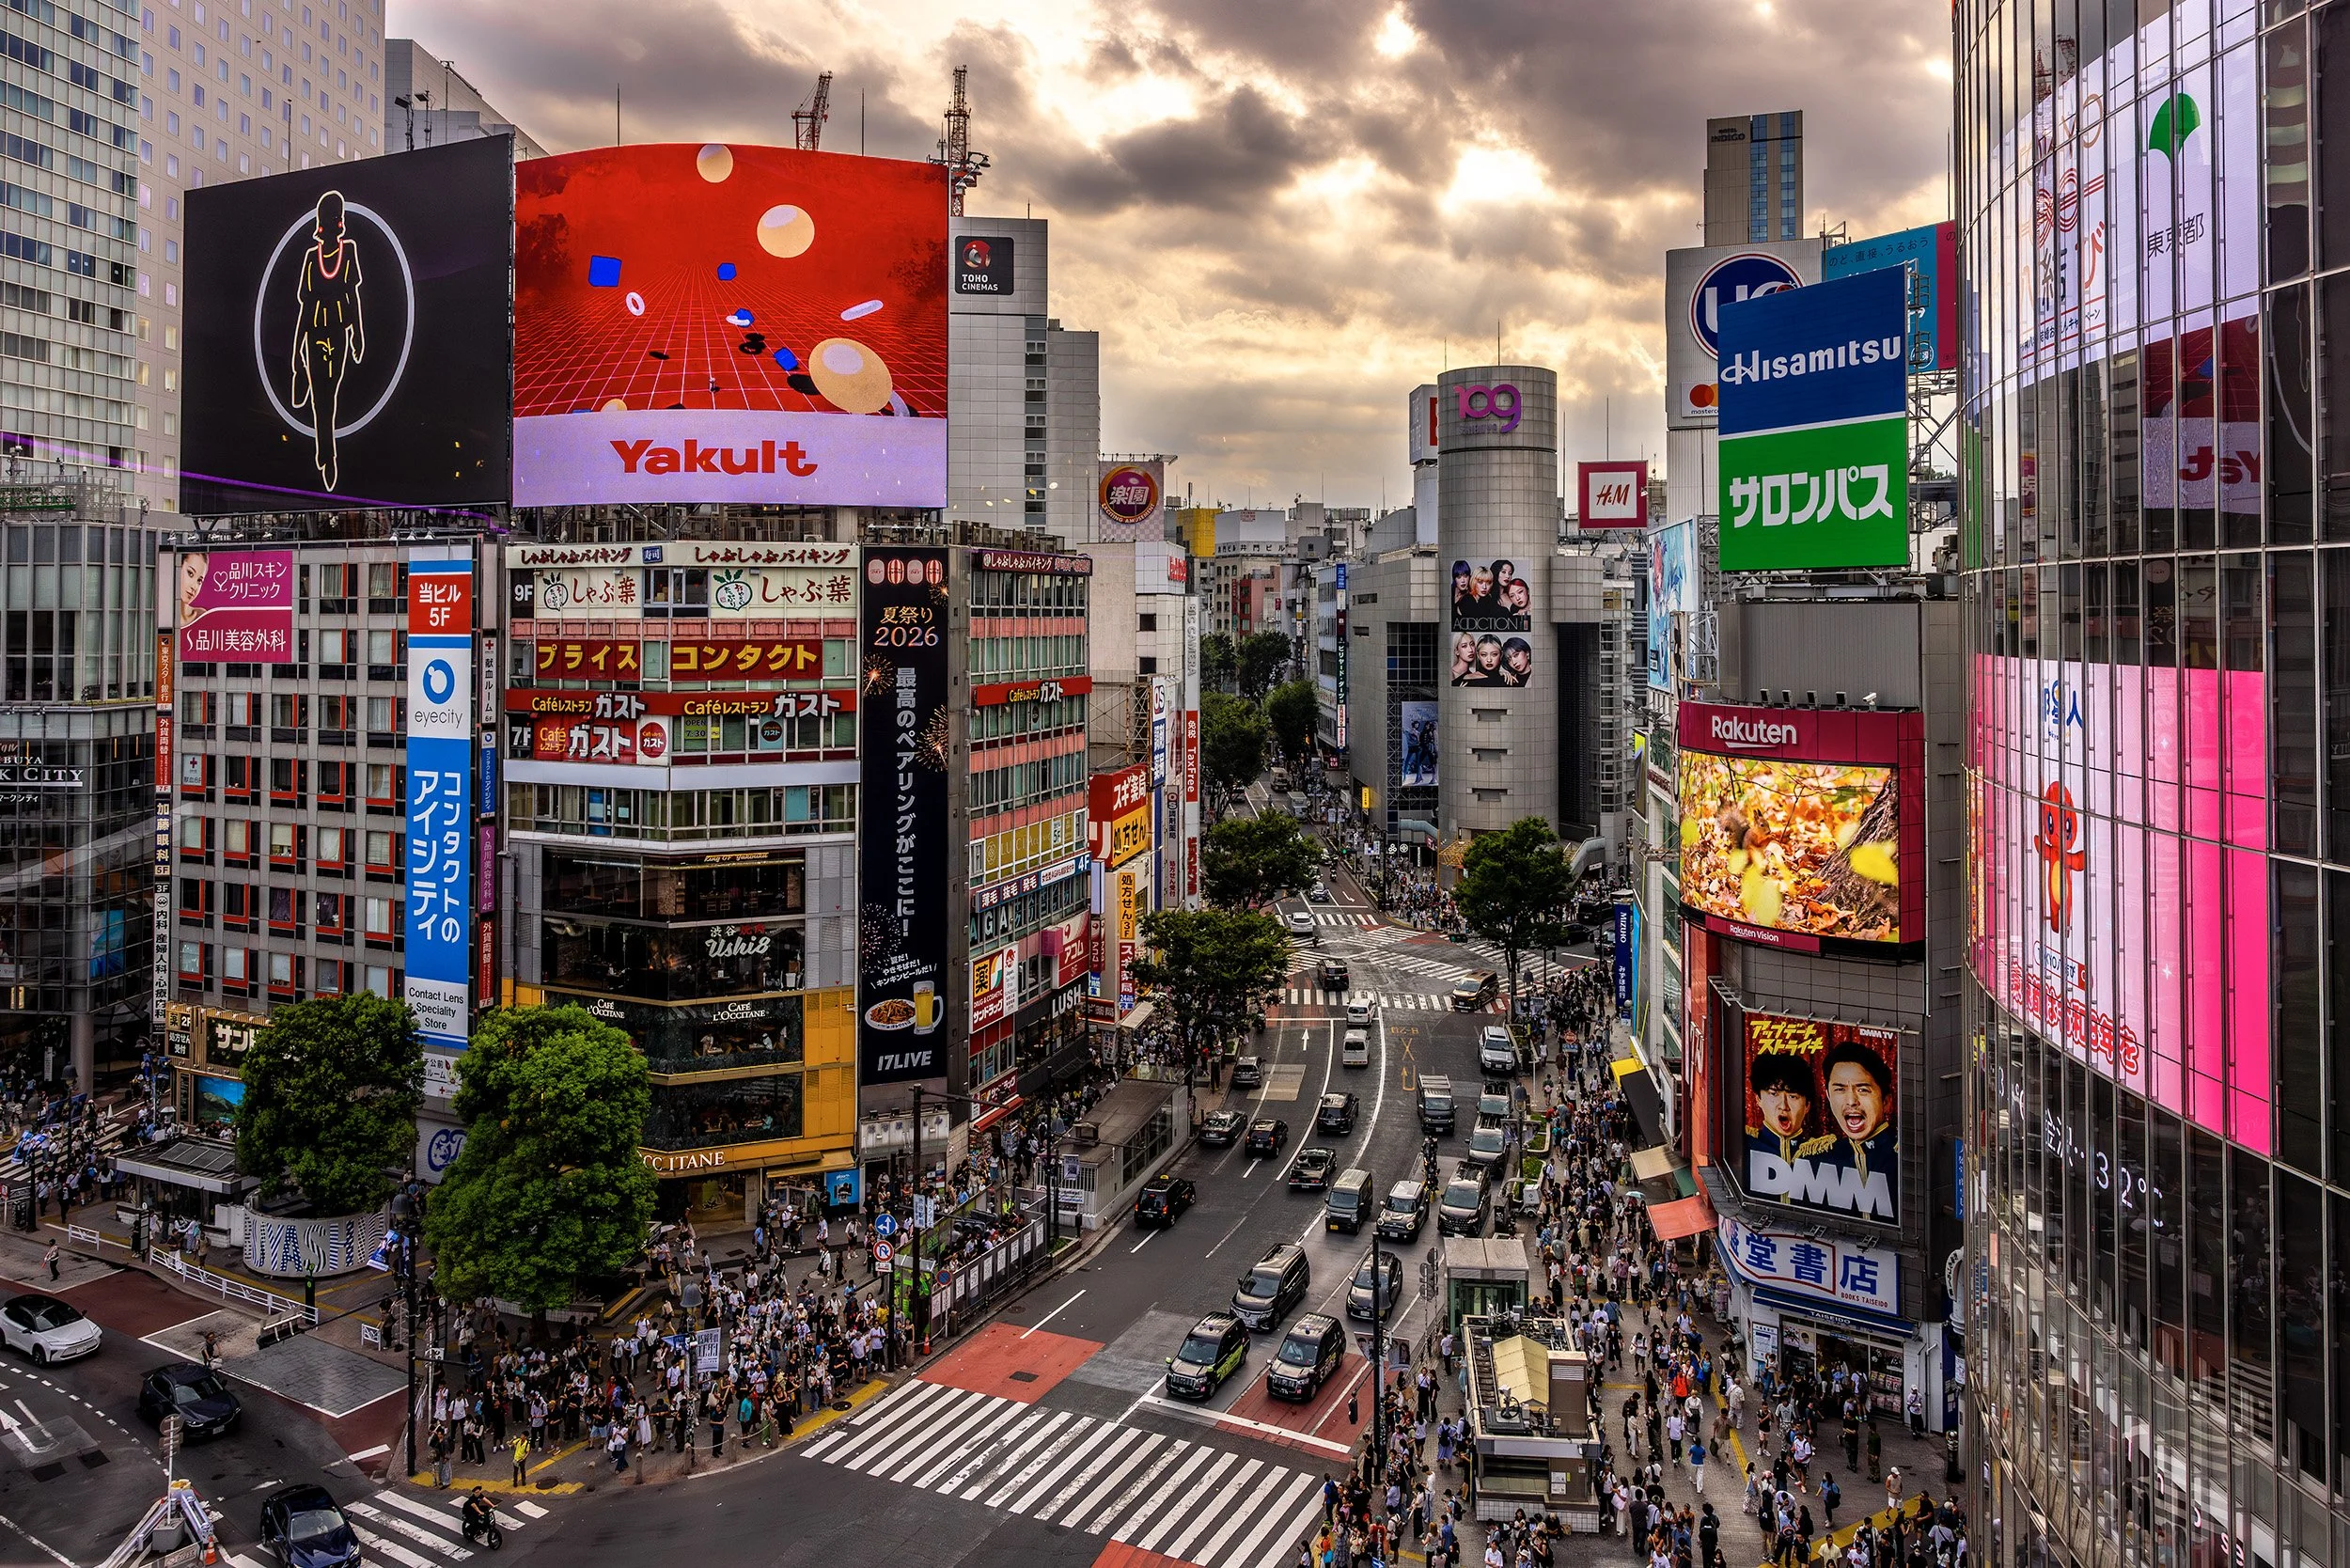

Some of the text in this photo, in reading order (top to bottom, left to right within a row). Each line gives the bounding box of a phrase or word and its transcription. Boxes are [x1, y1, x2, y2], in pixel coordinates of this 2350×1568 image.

[1711, 133, 1746, 142] INDIGO
[1452, 384, 1522, 433] 109
[610, 439, 818, 477] Yakult
[1109, 484, 1150, 505] 楽園
[1596, 483, 1630, 506] H&M
[1730, 464, 1893, 528] サロンパス
[521, 546, 632, 564] しゃぶしゃぶバイキング
[644, 547, 660, 563] 寿司
[695, 546, 851, 564] しゃぶしゃぶバイキング
[1240, 543, 1286, 552] 井門ビル
[229, 561, 287, 580] 品川スキン
[229, 581, 281, 600] クリニック
[418, 584, 462, 605] 当ビル
[514, 584, 533, 602] 9F
[572, 575, 637, 604] しゃぶ葉
[760, 574, 852, 604] しゃぶ葉
[429, 607, 451, 627] 5F
[880, 605, 933, 624] 夏祭り
[1453, 617, 1518, 631] ADDICTION
[195, 628, 286, 653] 品川美容外科
[873, 626, 939, 647] 2026
[538, 643, 638, 670] プライス
[672, 644, 818, 672] コンタクト
[1187, 628, 1197, 676] CAMERA
[161, 647, 169, 702] 東京スター銀行
[484, 658, 494, 712] 献血ルーム
[1040, 682, 1063, 702] ガスト
[1154, 685, 1166, 715] OS
[595, 694, 646, 720] ガスト
[774, 694, 841, 718] ガスト
[415, 708, 463, 729] eyecity
[160, 717, 168, 755] 外貨両替
[511, 726, 532, 745] 7F
[540, 727, 566, 743] Café
[1712, 715, 1797, 745] Rakuten
[569, 724, 632, 759] ガスト
[643, 737, 664, 748] ガスト
[24, 768, 84, 781] CITY
[1188, 746, 1197, 792] TaxFree
[1113, 770, 1146, 811] スギ薬局
[156, 802, 169, 861] 加藤眼科
[1114, 815, 1147, 856] 処方せん
[412, 770, 439, 941] アイシティ
[441, 772, 462, 943] コンタクトの
[1078, 855, 1090, 871] 4F
[156, 866, 168, 874] 5F
[156, 884, 168, 893] 3F
[981, 889, 998, 908] 薄毛
[1002, 882, 1018, 900] 抜毛
[1023, 874, 1038, 891] 発毛
[1121, 874, 1134, 920] 処方せん
[482, 902, 492, 911] 4F
[155, 910, 167, 929] 内科
[1123, 921, 1131, 938] 3F
[710, 925, 737, 937] 渋谷
[1730, 924, 1778, 943] Rakuten Vision
[482, 921, 492, 964] 外貨両替
[1064, 940, 1084, 964] アコム
[155, 933, 167, 975] 産婦人科
[975, 964, 989, 995] 薬
[154, 976, 167, 1022] 心療内科
[409, 987, 464, 1004] Contact Lens
[1052, 984, 1082, 1018] LUSH
[169, 1012, 179, 1026] 薬
[416, 1002, 456, 1017] Speciality
[973, 998, 1004, 1024] サンドラッグ
[425, 1018, 447, 1030] Store
[1749, 1020, 1817, 1040] アップデート
[1859, 1028, 1894, 1040] DMM TV
[174, 1044, 186, 1055] 受付
[1757, 1038, 1824, 1056] ストライキ
[877, 1050, 932, 1072] 17LIVE
[637, 1150, 725, 1171] CCITANE
[1749, 1149, 1894, 1218] DMM
[1841, 1292, 1888, 1309] BOOKS TAISEIDO
[1810, 1311, 1851, 1325] TAISEIDO
